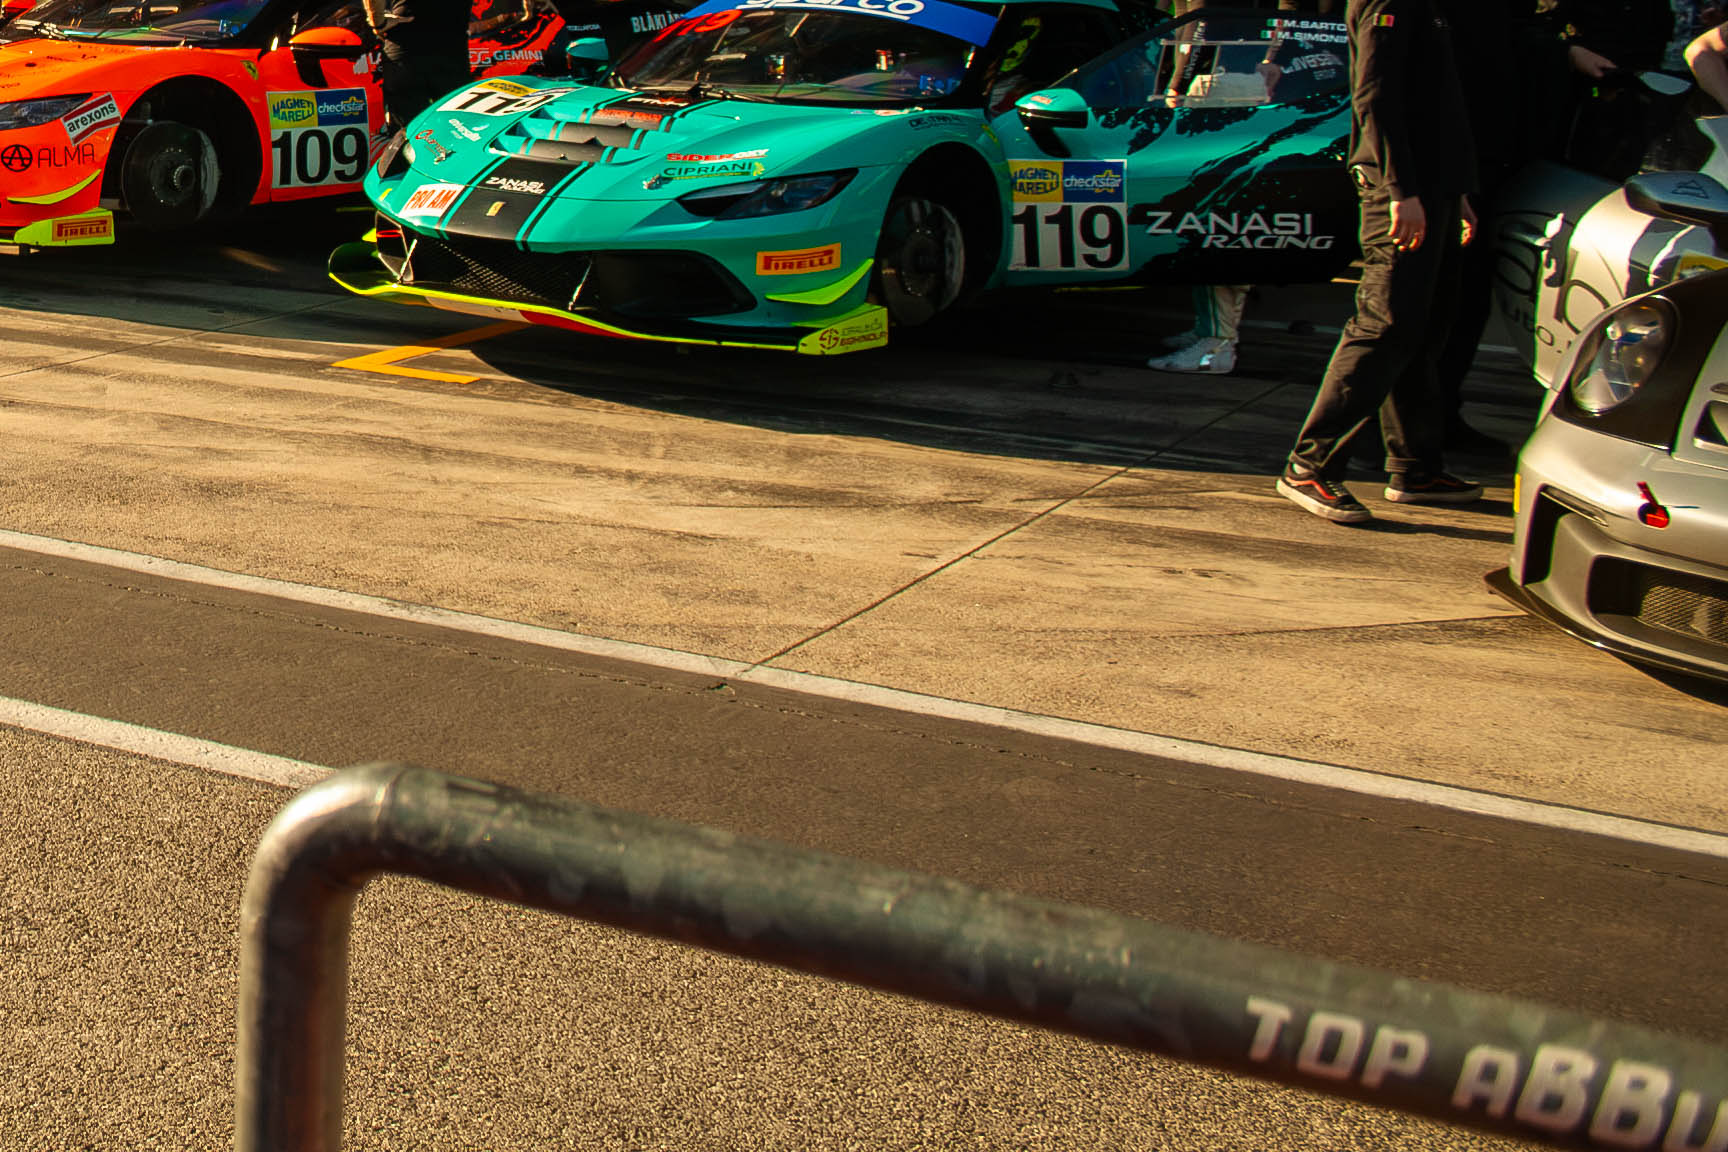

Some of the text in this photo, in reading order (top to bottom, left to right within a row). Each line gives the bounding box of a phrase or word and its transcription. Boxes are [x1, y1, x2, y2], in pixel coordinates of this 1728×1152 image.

[493, 50, 543, 61] GEMINI
[66, 101, 117, 134] arexons
[317, 101, 365, 114] checkstar
[38, 143, 95, 169] ALMA
[271, 126, 369, 186] 109
[663, 162, 753, 178] CIPRIANI
[1063, 172, 1122, 189] checkstar
[485, 176, 545, 190] ZANASI
[428, 189, 458, 211] AM
[57, 218, 108, 238] PIRELLI
[1145, 211, 1313, 235] ZANASI
[1012, 204, 1127, 270] 119
[1201, 234, 1336, 249] RACING
[763, 249, 835, 271] PIRELLI
[1245, 994, 1430, 1089] TOP
